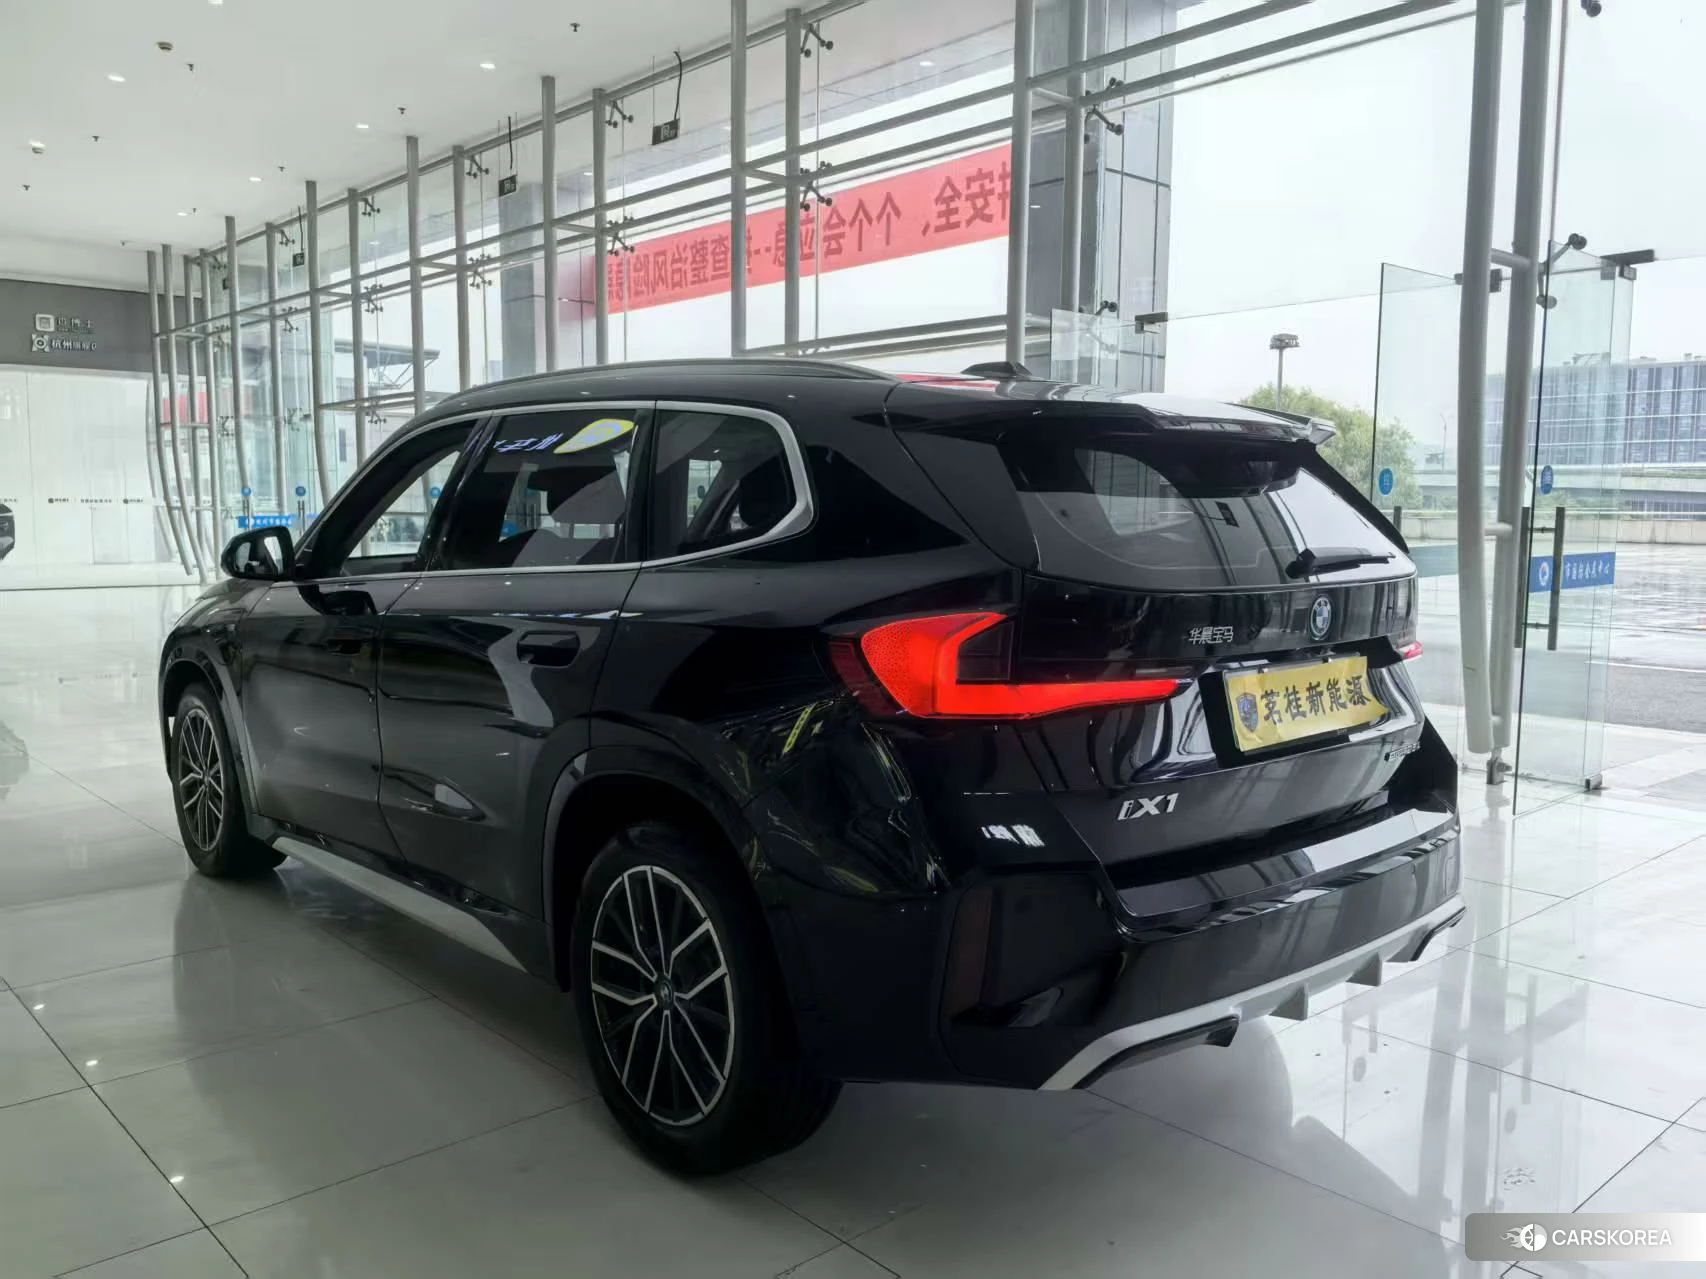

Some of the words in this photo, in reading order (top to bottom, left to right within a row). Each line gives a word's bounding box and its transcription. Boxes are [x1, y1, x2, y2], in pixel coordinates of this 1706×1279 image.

[1188, 626, 1233, 645] 华晨宝马
[1117, 792, 1179, 821] iX1
